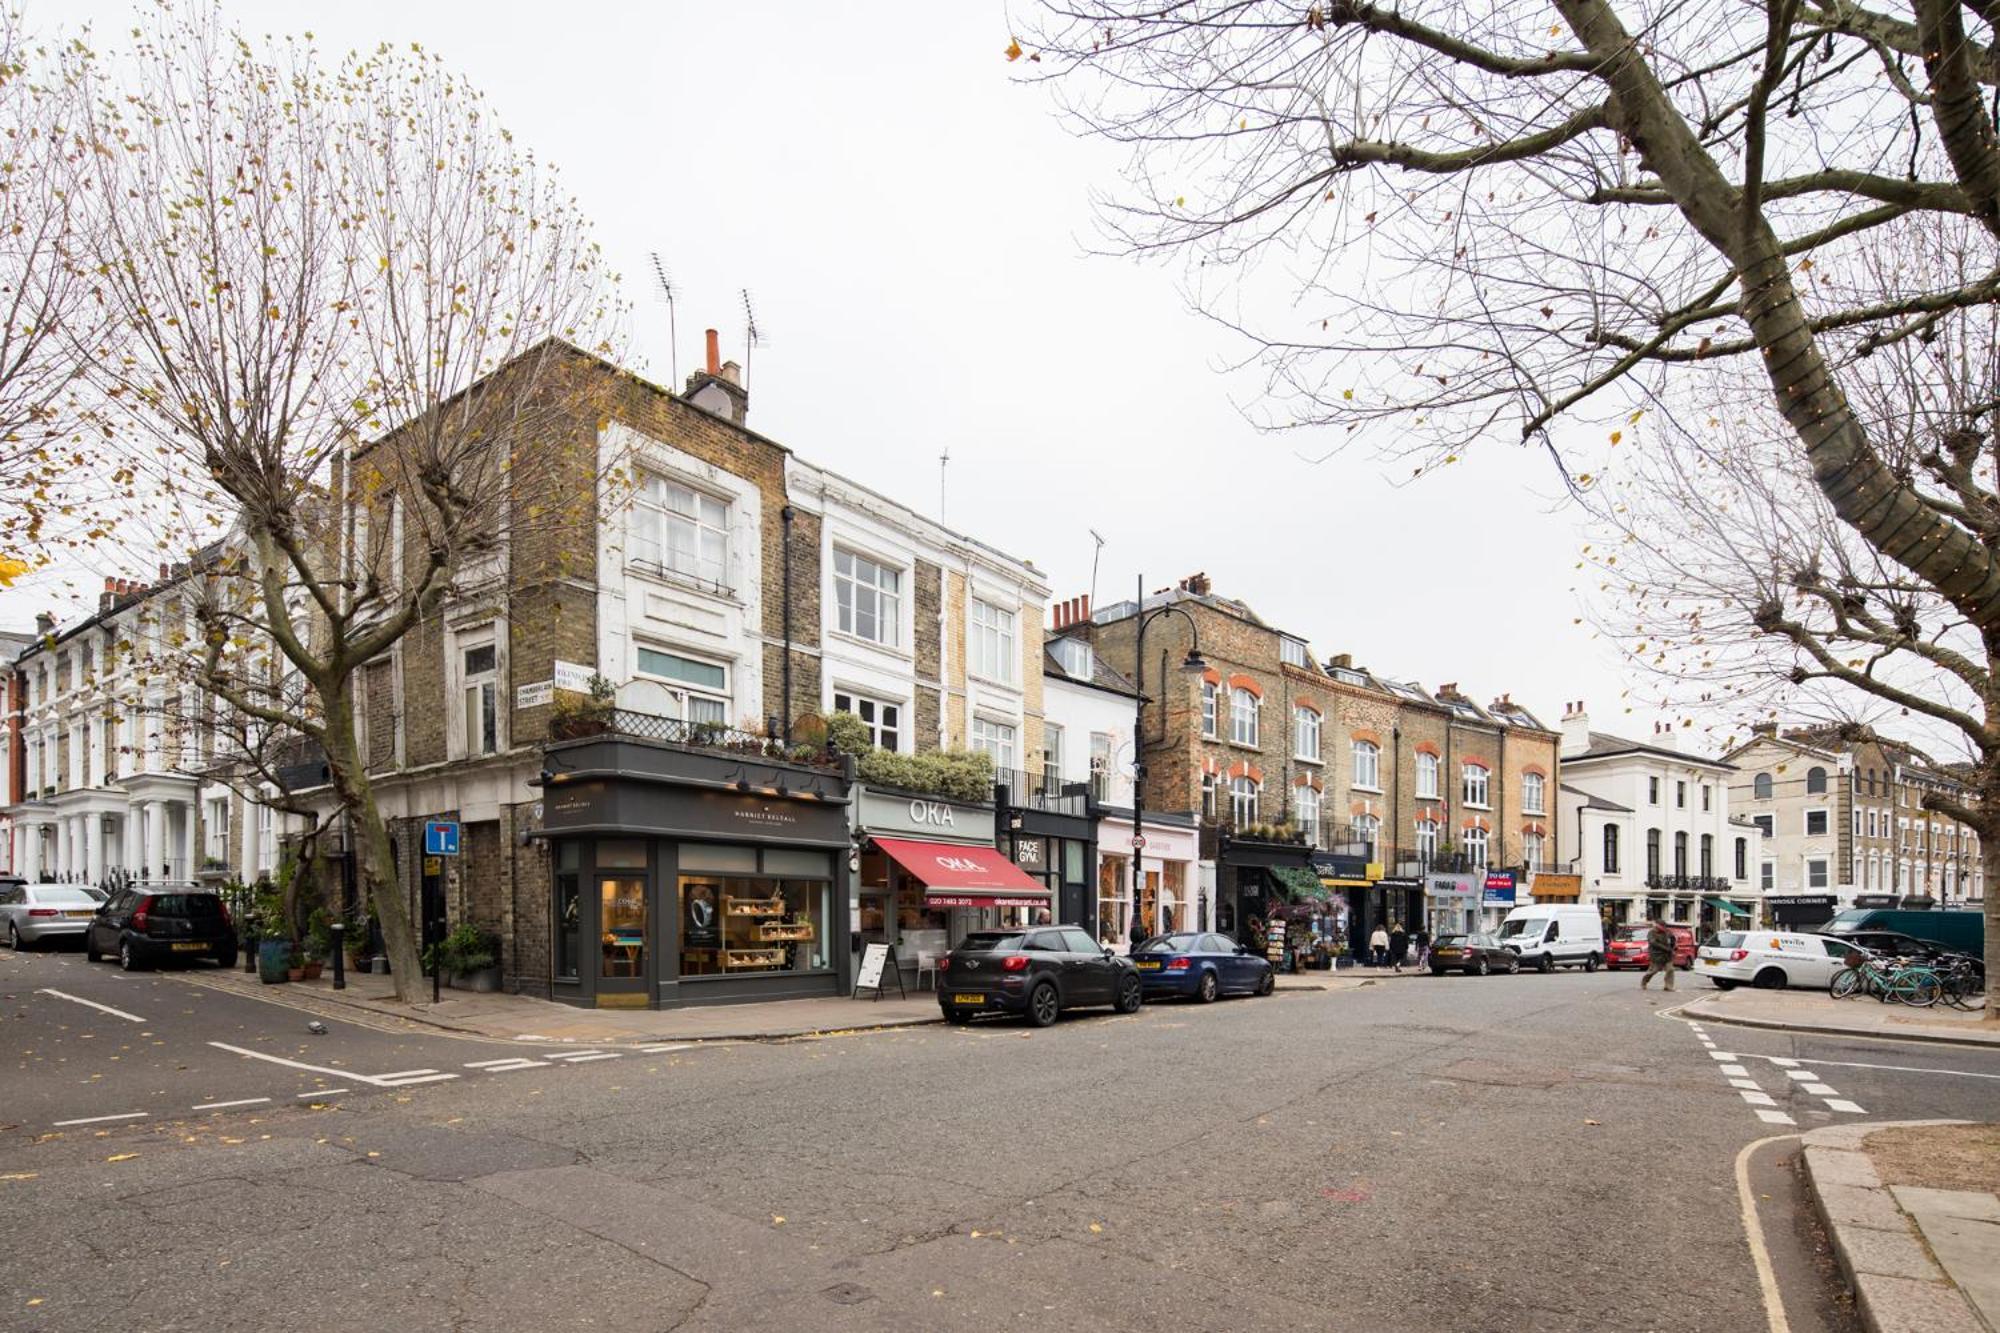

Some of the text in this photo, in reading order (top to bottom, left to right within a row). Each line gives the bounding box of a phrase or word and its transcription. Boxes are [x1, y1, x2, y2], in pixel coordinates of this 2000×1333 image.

[519, 695, 538, 704] STREET
[909, 799, 954, 827] OKA
[1019, 840, 1038, 852] FACE
[936, 857, 983, 870] OKA
